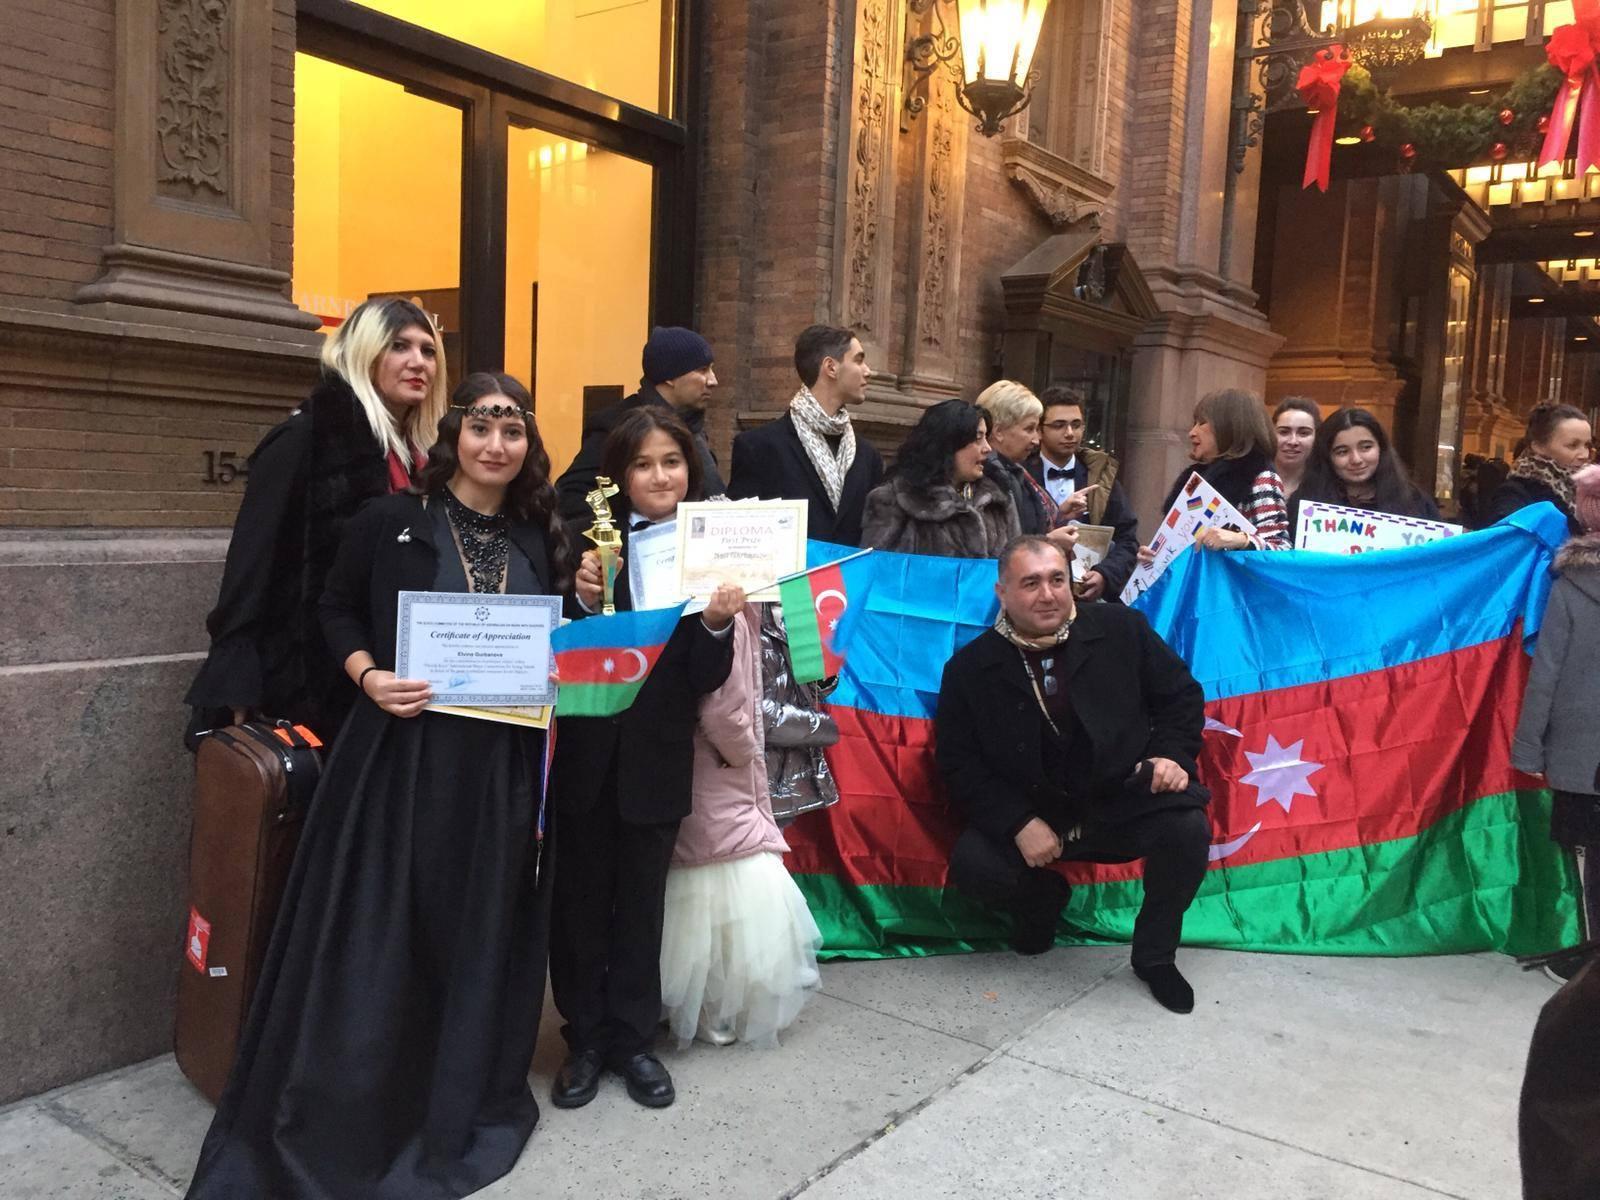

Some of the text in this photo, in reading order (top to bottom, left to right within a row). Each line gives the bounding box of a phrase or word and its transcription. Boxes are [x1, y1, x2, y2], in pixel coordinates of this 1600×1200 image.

[711, 526, 774, 536] DIPLOMA
[1312, 518, 1433, 546] THANK YO
[430, 631, 531, 641] Certificate of Appreciation
